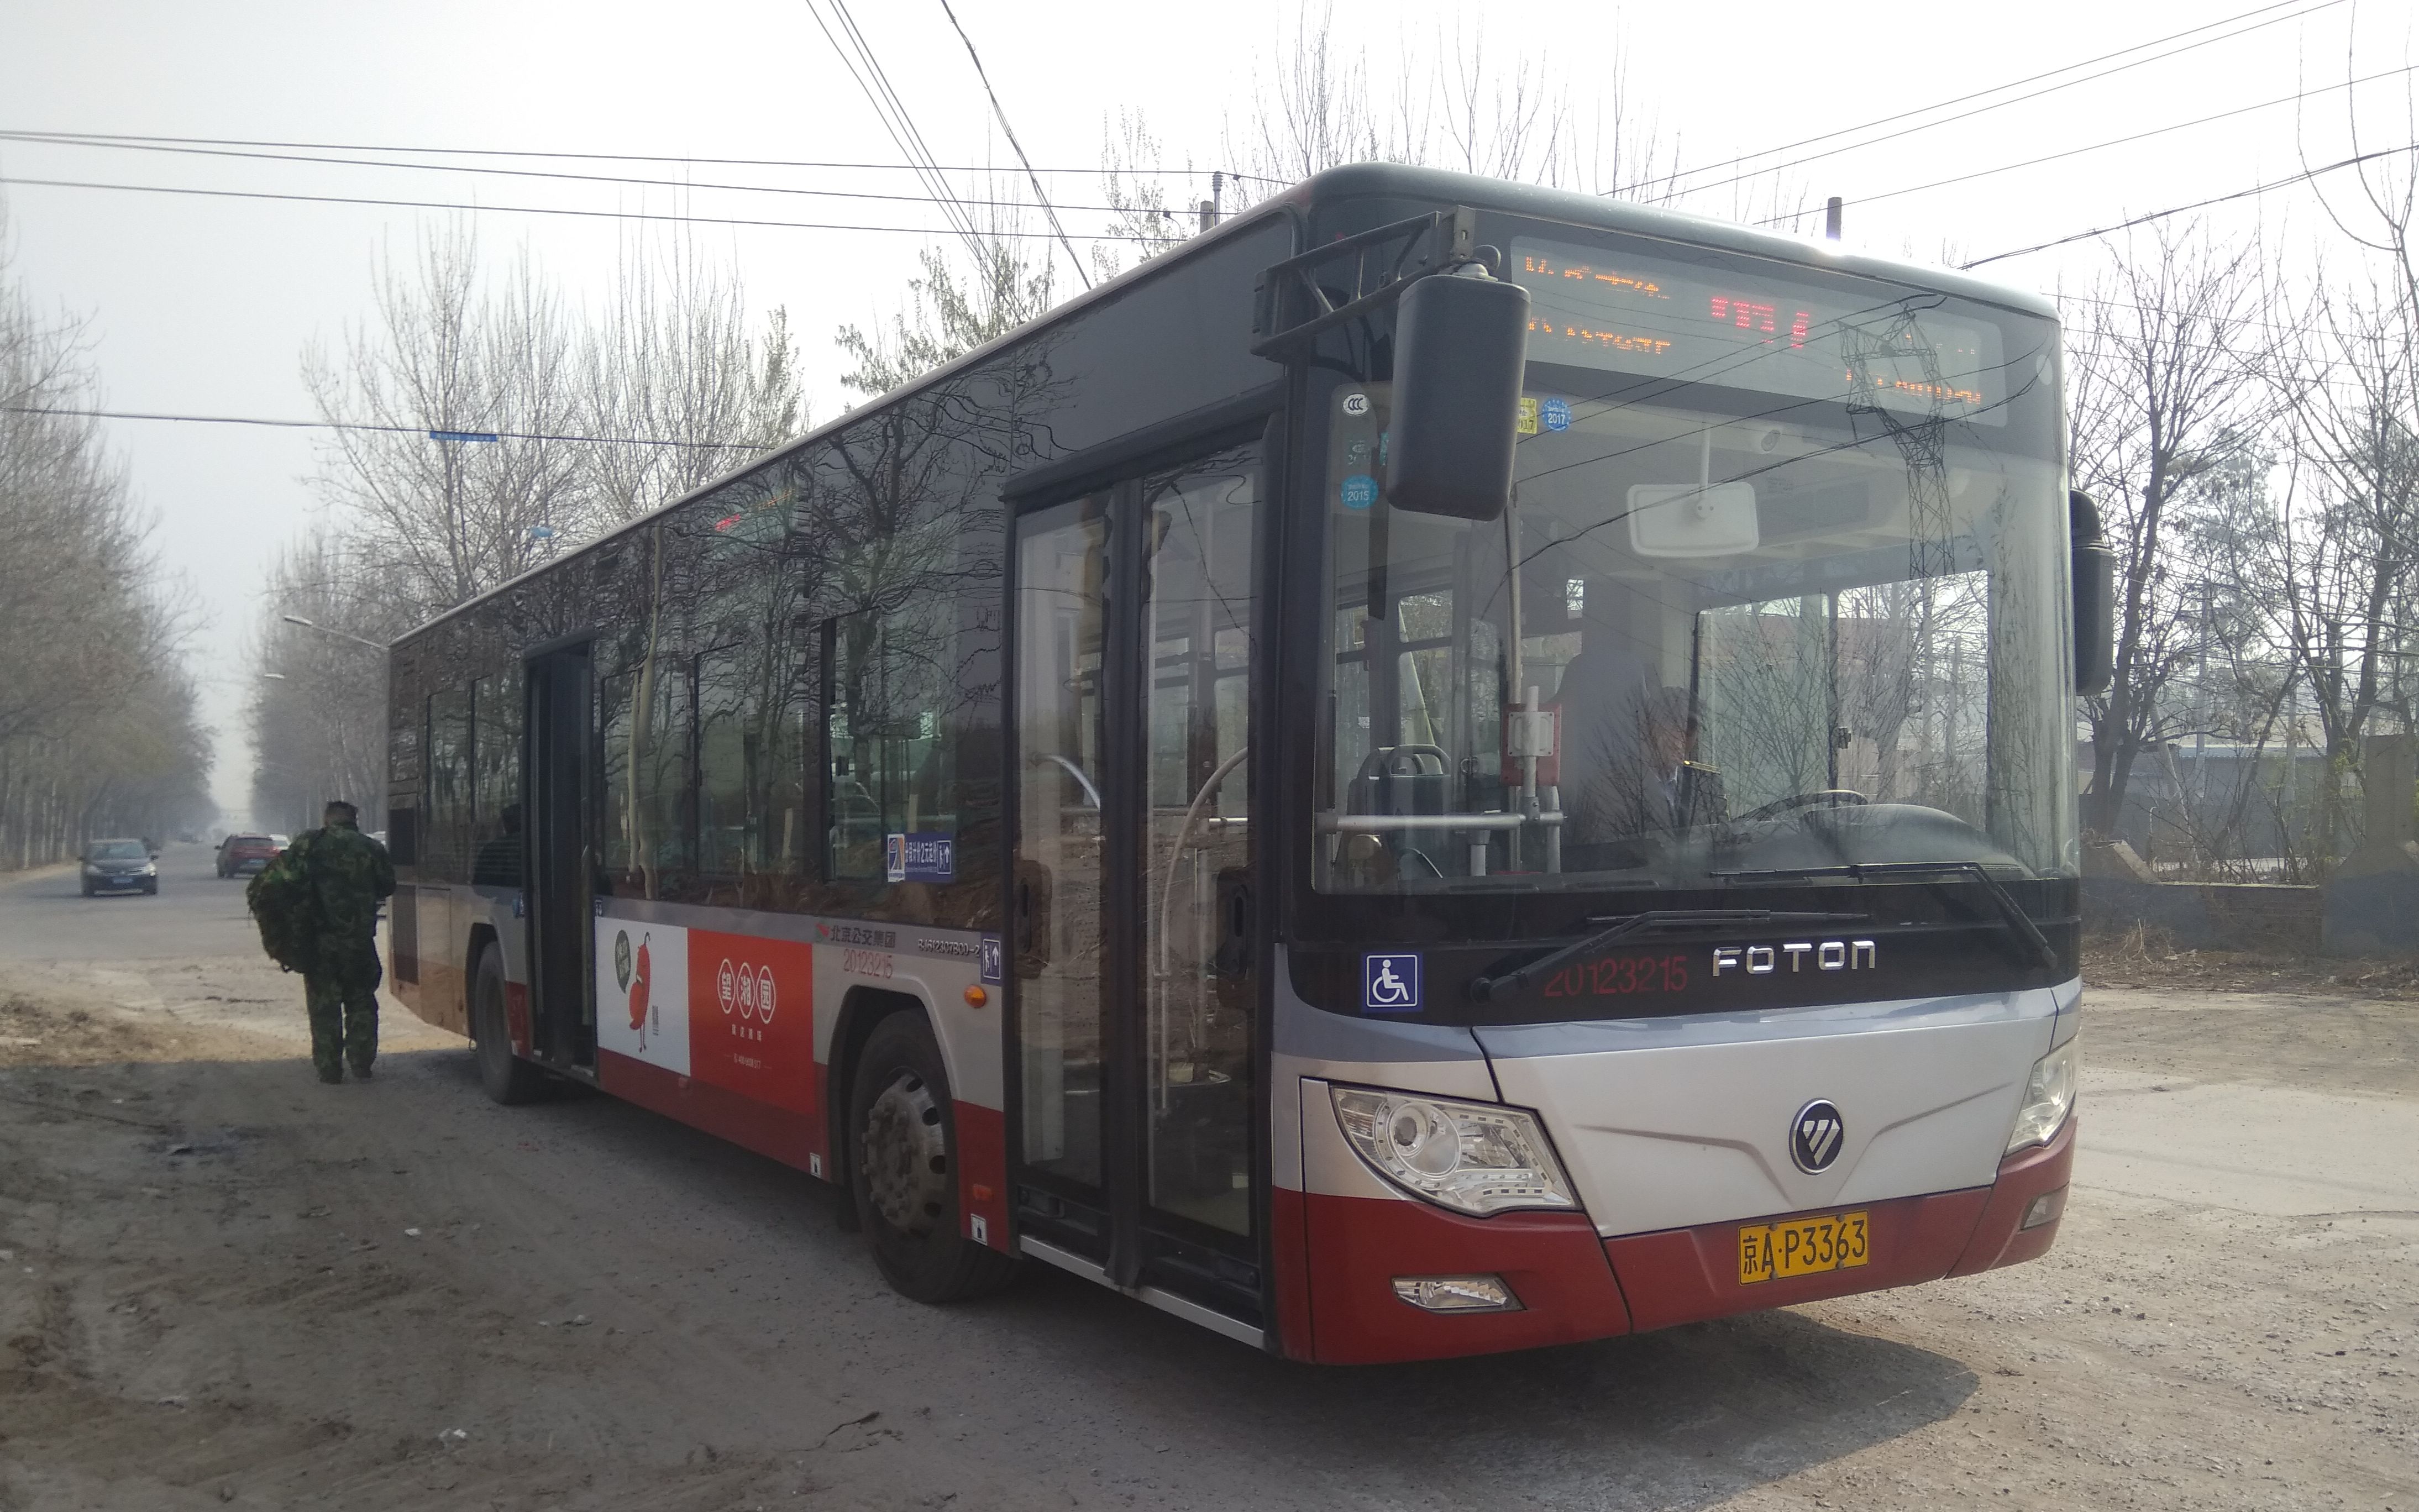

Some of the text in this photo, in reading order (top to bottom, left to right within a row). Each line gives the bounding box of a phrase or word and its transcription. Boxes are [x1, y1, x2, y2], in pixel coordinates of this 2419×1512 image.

[1518, 419, 1534, 430] 017
[1547, 412, 1566, 425] 2017
[1347, 490, 1369, 502] 2015
[830, 924, 896, 948] 北京公交集团
[843, 948, 893, 979] 20123215
[1712, 941, 1875, 977] FOTON
[1544, 955, 1688, 998] 20123215
